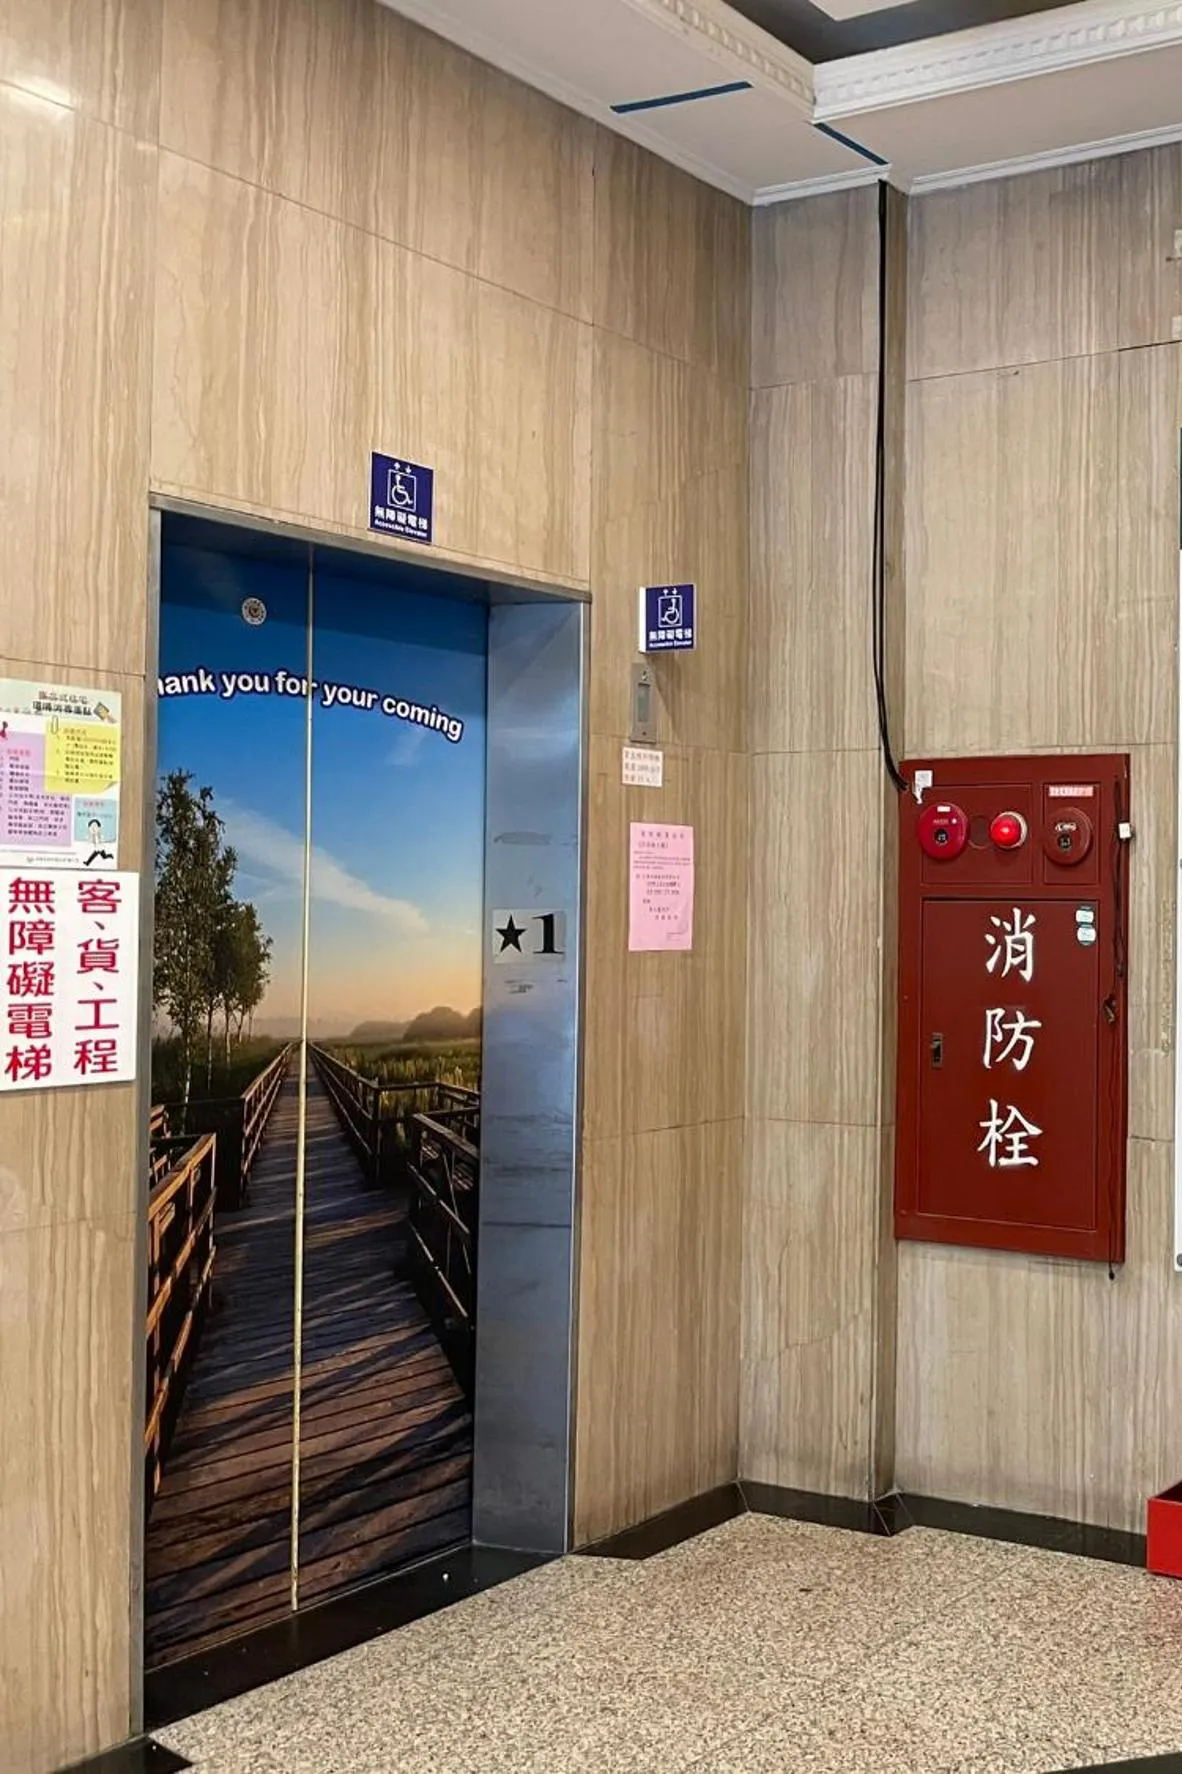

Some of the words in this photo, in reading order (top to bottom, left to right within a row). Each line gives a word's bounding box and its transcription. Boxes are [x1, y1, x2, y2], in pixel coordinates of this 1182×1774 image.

[221, 673, 270, 697] you
[275, 670, 318, 696] for
[322, 683, 377, 706] your
[382, 696, 463, 741] coming
[4, 877, 56, 1082] 無障礙電梯
[73, 879, 122, 1075] 客、貨、工程
[532, 912, 565, 954] 1
[977, 906, 1043, 1169] 消防栓
